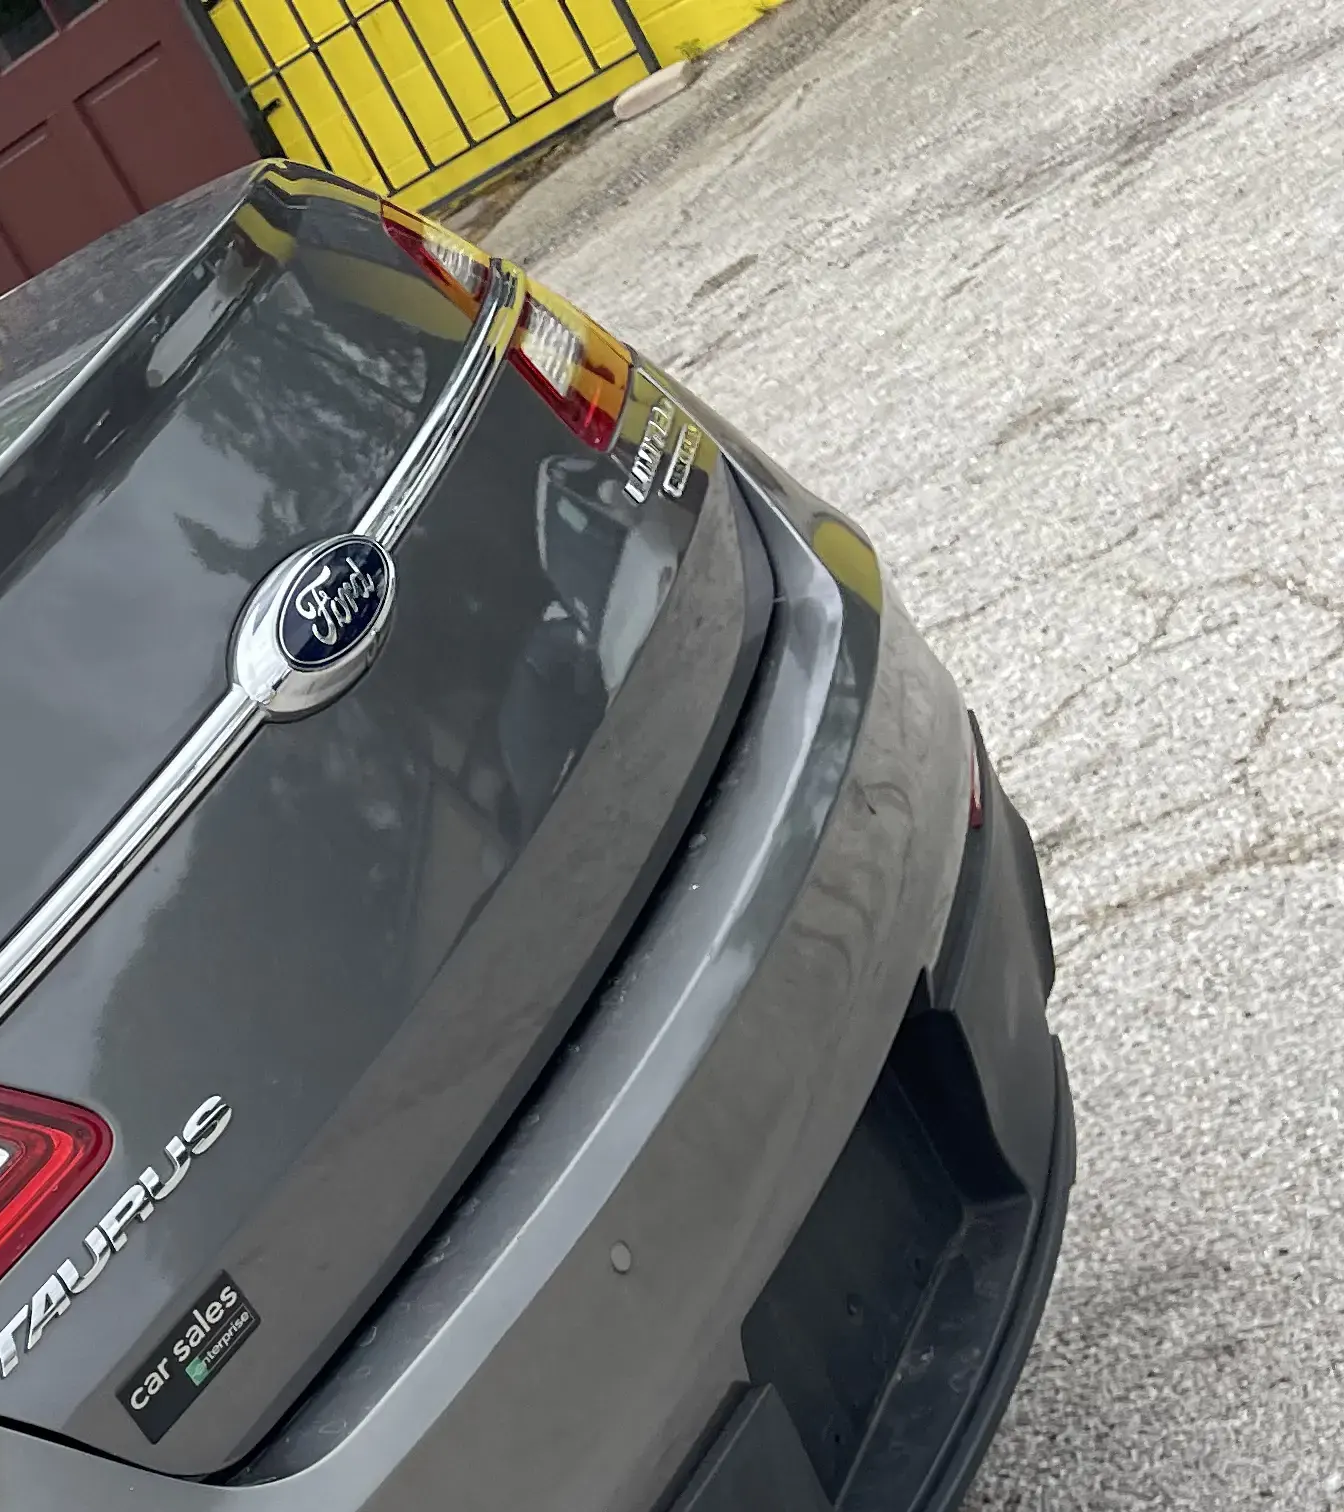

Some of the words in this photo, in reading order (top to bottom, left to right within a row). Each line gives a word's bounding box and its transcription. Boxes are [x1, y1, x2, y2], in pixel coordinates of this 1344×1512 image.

[296, 556, 374, 645] Ford
[130, 1358, 170, 1410] car
[173, 1284, 237, 1362] sales
[195, 1310, 250, 1375] enterprise
